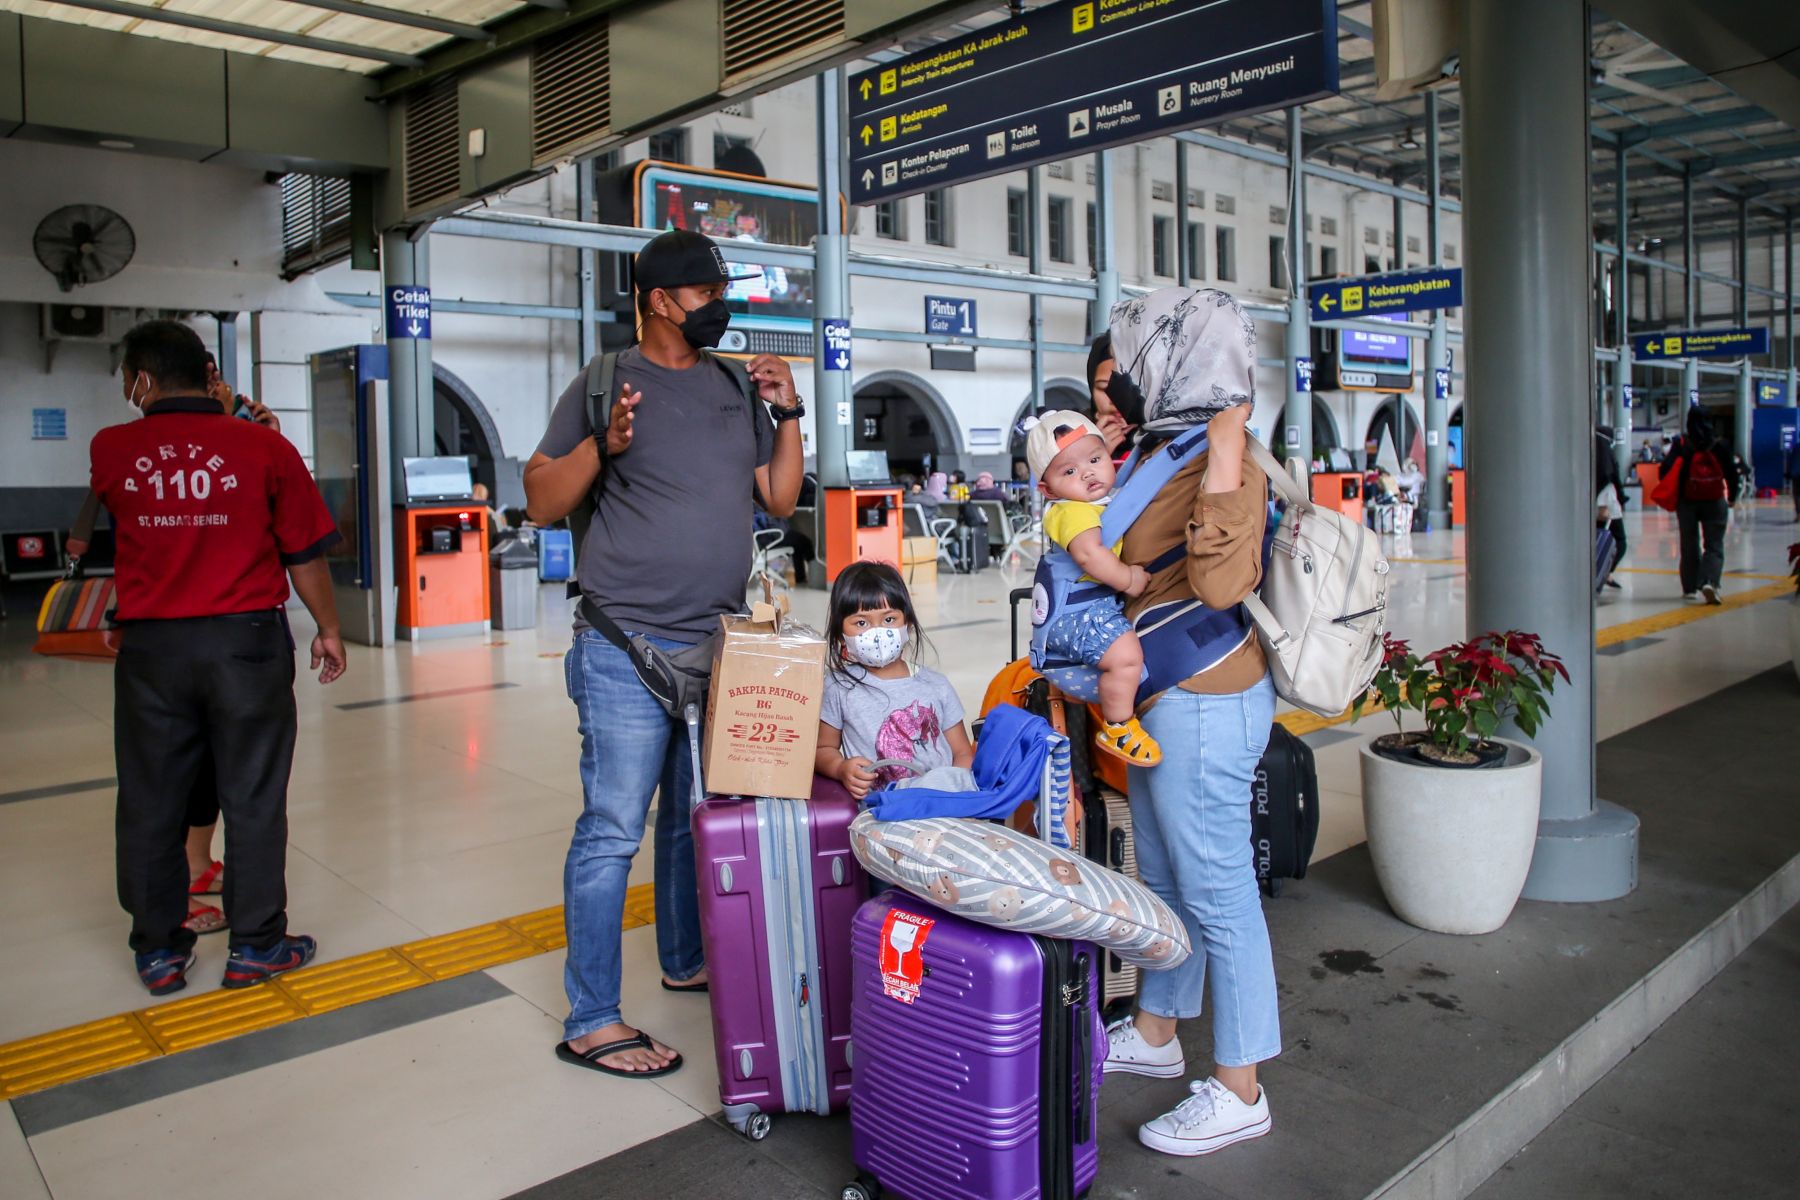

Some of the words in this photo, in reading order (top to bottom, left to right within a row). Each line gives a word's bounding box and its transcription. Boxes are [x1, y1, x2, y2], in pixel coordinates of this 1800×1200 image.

[901, 48, 962, 76] Keberangkatan
[963, 42, 978, 56] KA
[979, 33, 1004, 50] Jarak
[1005, 25, 1028, 41] Jauh
[1189, 76, 1228, 95] Ruang
[1230, 56, 1294, 85] Menyusui
[1190, 93, 1220, 107] Nursery
[1220, 87, 1243, 100] Room
[901, 103, 948, 124] Kedatangan
[1095, 99, 1133, 118] Musala
[1096, 119, 1119, 131] Prayer
[1120, 113, 1141, 126] Room
[1010, 124, 1037, 140] Toilet
[1011, 139, 1040, 152] Restroom
[902, 153, 928, 169] Konter
[929, 143, 970, 162] Pelaporan
[902, 167, 926, 180] Check-in
[926, 162, 948, 174] Counter
[393, 290, 430, 304] Cetak
[1368, 279, 1450, 297] Keberangkatan
[395, 305, 429, 319] Tiket
[930, 300, 956, 316] Pintu
[1368, 298, 1405, 309] Departures
[931, 318, 949, 331] Gate
[959, 302, 974, 333] 1
[824, 325, 850, 338] Ceta
[827, 338, 850, 349] Tike
[125, 444, 238, 492] PORTER
[148, 469, 211, 500] 110
[154, 515, 192, 527] PASAR
[193, 514, 228, 525] SENEN
[728, 686, 766, 698] BAKPIA
[769, 686, 809, 705] PATHOK
[756, 700, 772, 709] BG
[735, 710, 757, 719] Kacang
[748, 722, 778, 743] 23
[1256, 770, 1269, 815] POLO
[1258, 839, 1271, 878] POLO
[893, 911, 929, 926] FRAGILE
